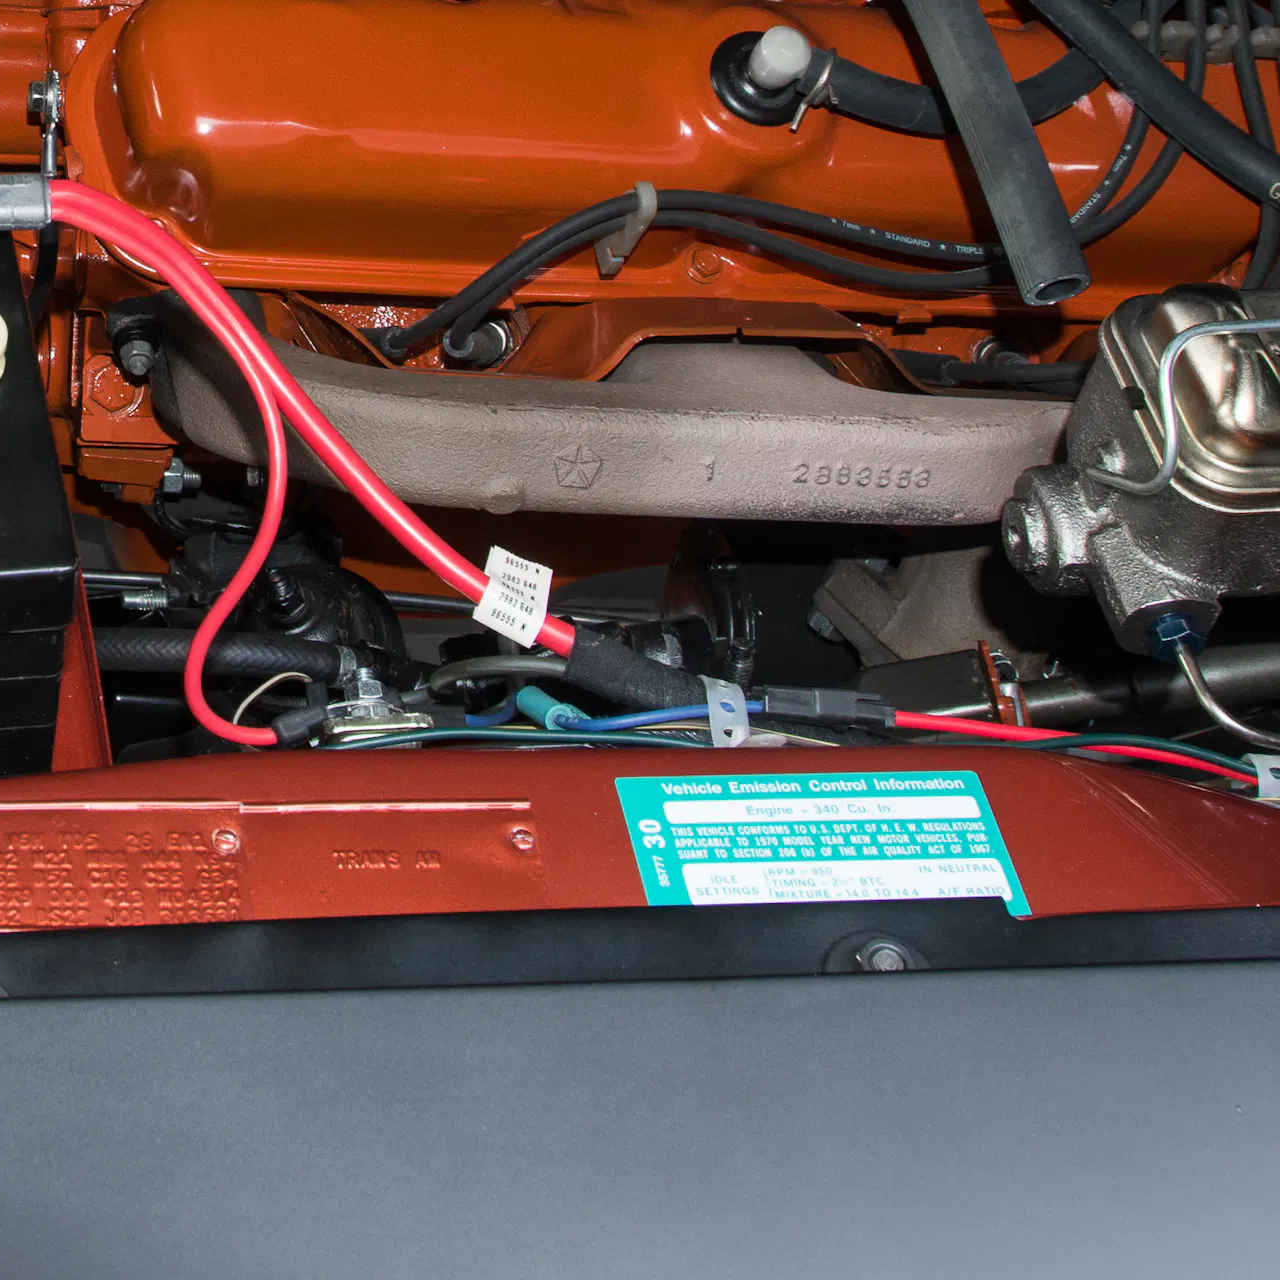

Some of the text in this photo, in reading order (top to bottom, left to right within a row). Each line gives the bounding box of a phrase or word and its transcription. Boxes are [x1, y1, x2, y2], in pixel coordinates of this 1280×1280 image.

[884, 231, 985, 255] STANDARD TRIPLE
[505, 556, 540, 575] 96555 N
[501, 572, 521, 585] 2983
[523, 580, 538, 591] 648
[490, 608, 527, 632] 96555 N
[661, 777, 965, 796] Vehicle Emission Control Information
[745, 803, 896, 818] Engine 340 Cu. In.
[637, 818, 667, 850] 30
[670, 821, 987, 837] THIS VEHICLE CONFORMS TO U.S. DEPT. OF REGULATIONS
[674, 837, 732, 849] APPLICABLE
[735, 837, 749, 847] TO
[754, 836, 779, 847] 1970
[782, 835, 816, 846] MODEL
[819, 834, 845, 845] YEAR
[849, 834, 871, 845] NEW
[877, 833, 911, 844] MOTOR
[967, 832, 989, 843] PUR-
[332, 850, 440, 869] TRANS AM
[677, 843, 995, 860] SUANT TO SECTION (b) OF THE AIR QUALITY ACT OF 1967.
[767, 863, 998, 877] RPM 950 IN NEUTRAL
[710, 874, 739, 885] IDLE
[772, 878, 817, 888] TIMING
[860, 876, 885, 886] BTC
[695, 886, 760, 897] SETTINGS
[774, 885, 1007, 900] MIXTURE TO A/F RATIO
